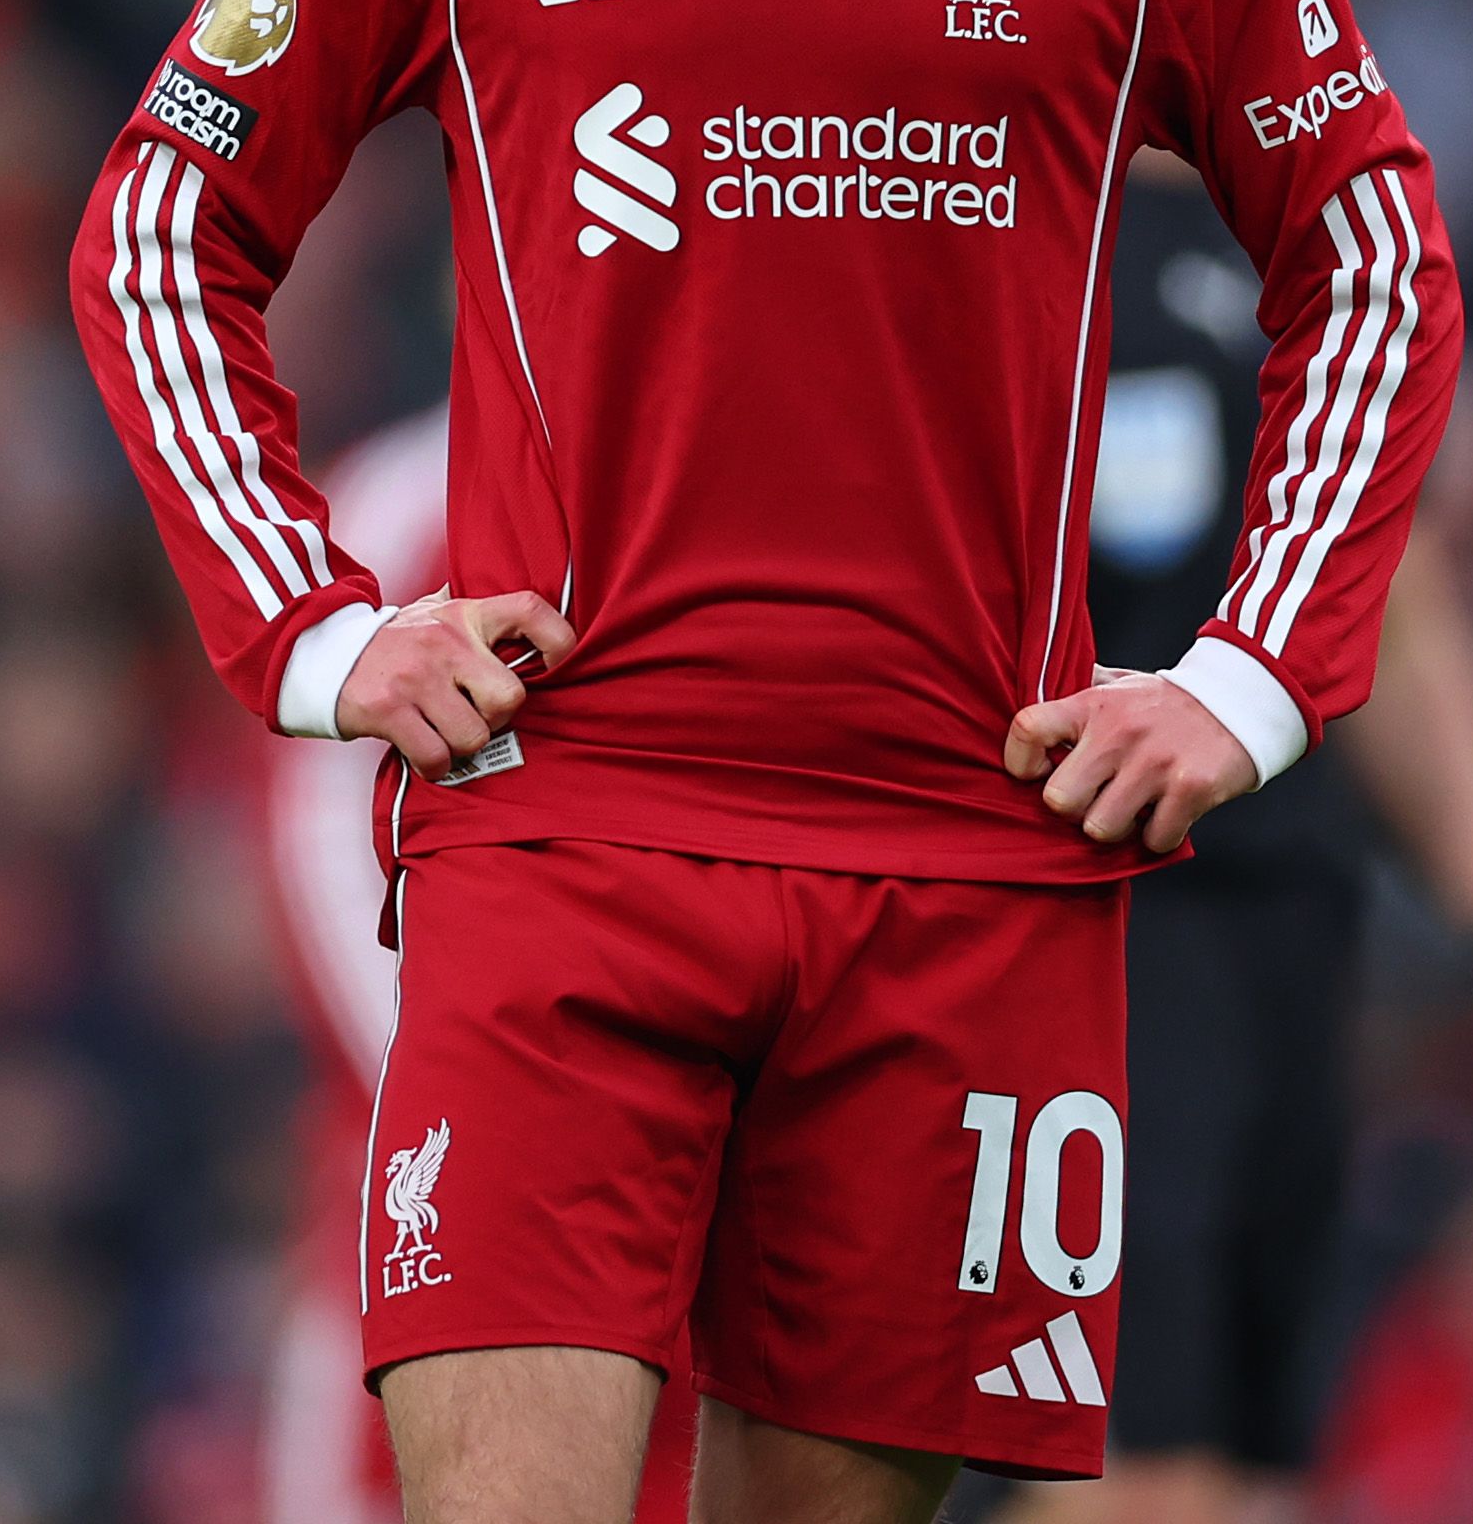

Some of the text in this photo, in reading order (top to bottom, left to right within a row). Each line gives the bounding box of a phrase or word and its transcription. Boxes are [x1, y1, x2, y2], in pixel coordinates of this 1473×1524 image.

[945, 4, 1027, 44] L.F.C.
[151, 93, 241, 161] racism
[702, 104, 1008, 169] standard
[705, 163, 1017, 229] chartered
[958, 1090, 1124, 1298] 10
[382, 1252, 453, 1298] L.F.C.
